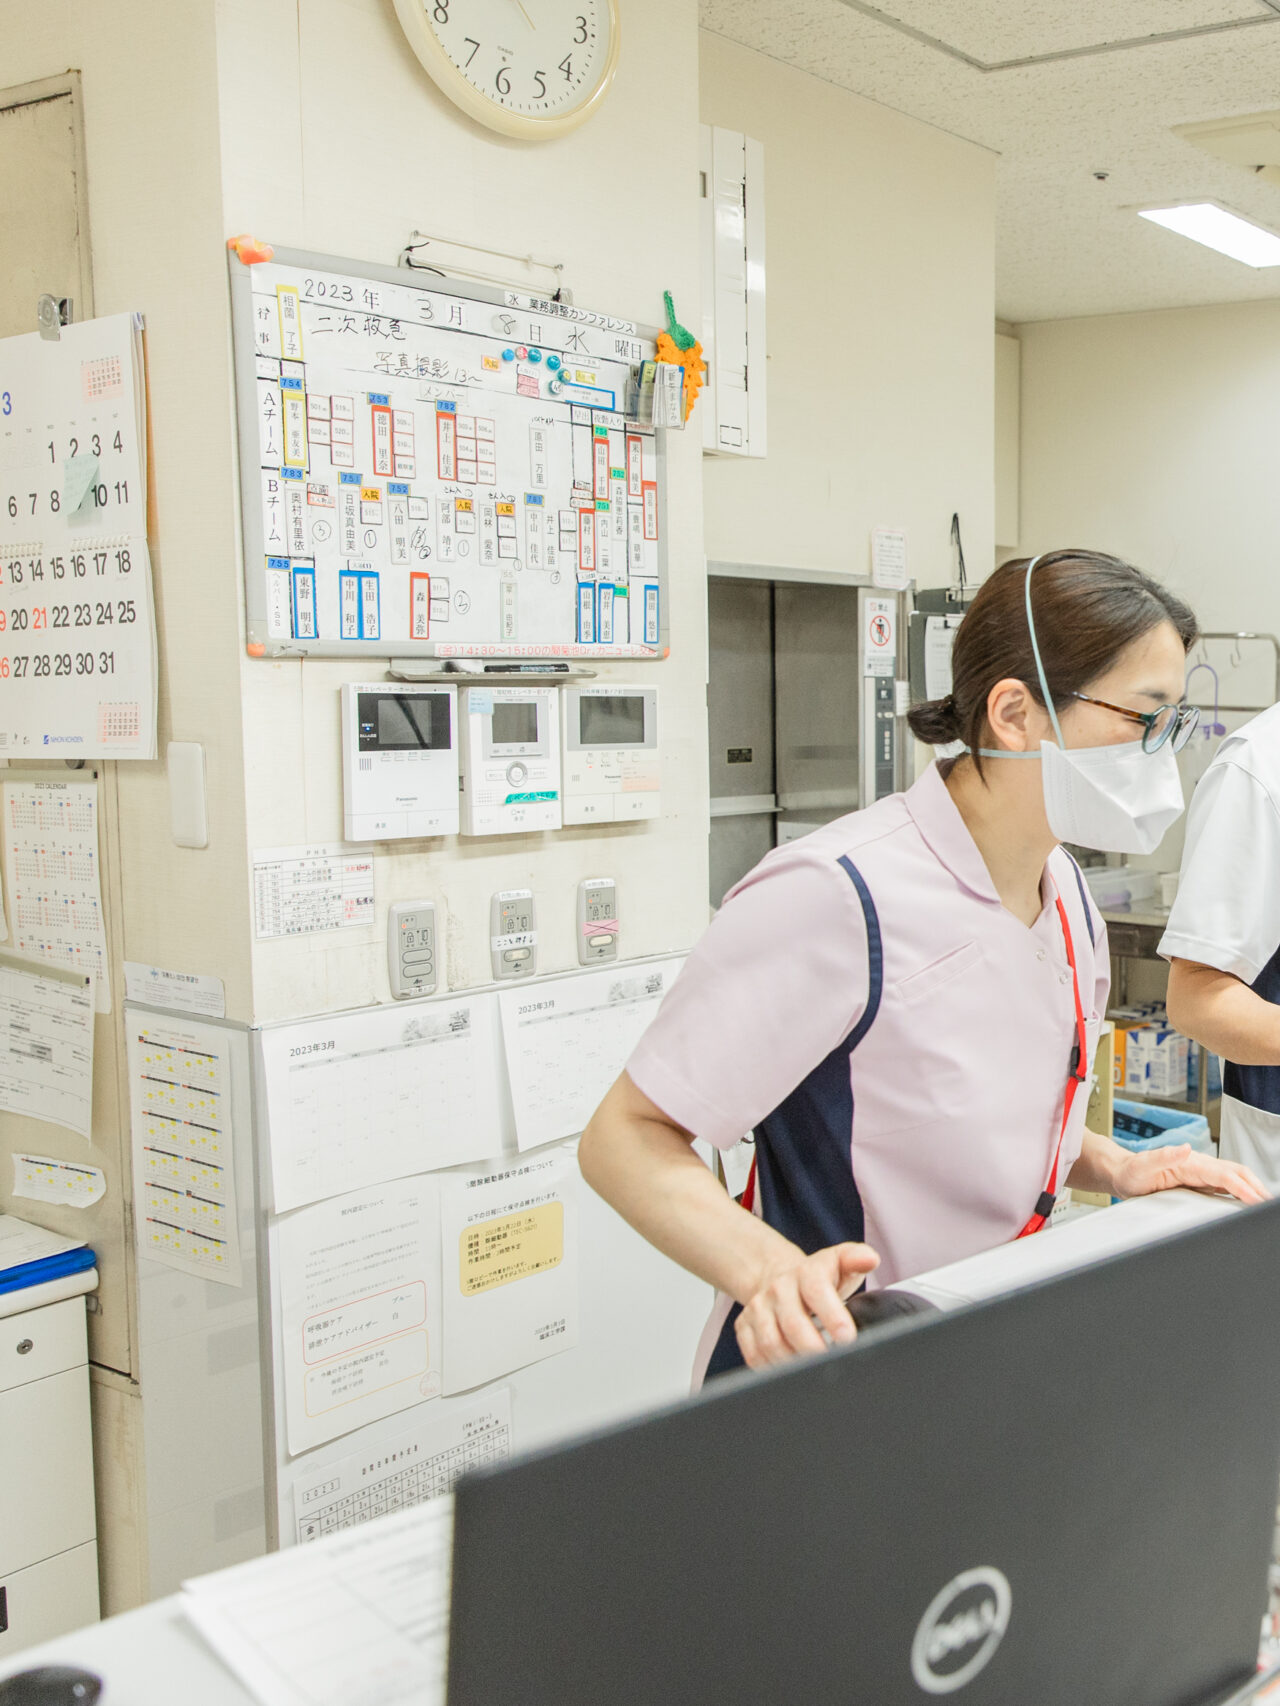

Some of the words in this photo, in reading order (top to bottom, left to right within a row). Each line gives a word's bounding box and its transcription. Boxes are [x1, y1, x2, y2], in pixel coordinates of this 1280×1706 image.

[573, 16, 588, 44] 3
[464, 37, 480, 68] 7
[495, 67, 511, 95] 6
[558, 53, 573, 82] 4
[532, 70, 546, 99] 5
[305, 279, 354, 302] 2023
[417, 299, 433, 320] 3
[449, 305, 462, 326] 月
[498, 314, 516, 335] 8
[530, 324, 541, 343] 日
[615, 339, 642, 361] 曜日
[282, 379, 301, 389] 754
[423, 386, 464, 398] メンバー
[2, 391, 12, 415] 3
[263, 392, 278, 455] Aチーム
[48, 441, 55, 463] 1
[70, 438, 78, 458] 2
[92, 434, 101, 457] 3
[113, 430, 123, 453] 4
[283, 468, 302, 478] 783
[8, 496, 18, 517] 6
[29, 493, 37, 515] 7
[50, 490, 60, 512] 8
[91, 484, 108, 507] 10
[114, 481, 129, 503] 11
[267, 480, 281, 542] Bチーム
[8, 561, 23, 583] 13
[29, 559, 44, 582] 14
[50, 557, 65, 579] 15
[71, 554, 86, 577] 16
[93, 553, 107, 575] 17
[115, 550, 131, 574] 18
[270, 560, 289, 568] 755
[0, 610, 6, 631] 9
[11, 608, 28, 630] 20
[33, 607, 47, 629] 21
[52, 605, 70, 628] 22
[74, 604, 92, 626] 23
[96, 602, 113, 625] 24
[118, 600, 136, 623] 25
[13, 656, 28, 677] 27
[33, 655, 50, 676] 28
[54, 653, 71, 675] 29
[76, 652, 94, 675] 30
[99, 651, 115, 674] 31
[518, 1000, 555, 1015] 2023年3月
[290, 1040, 336, 1057] 2023年3月
